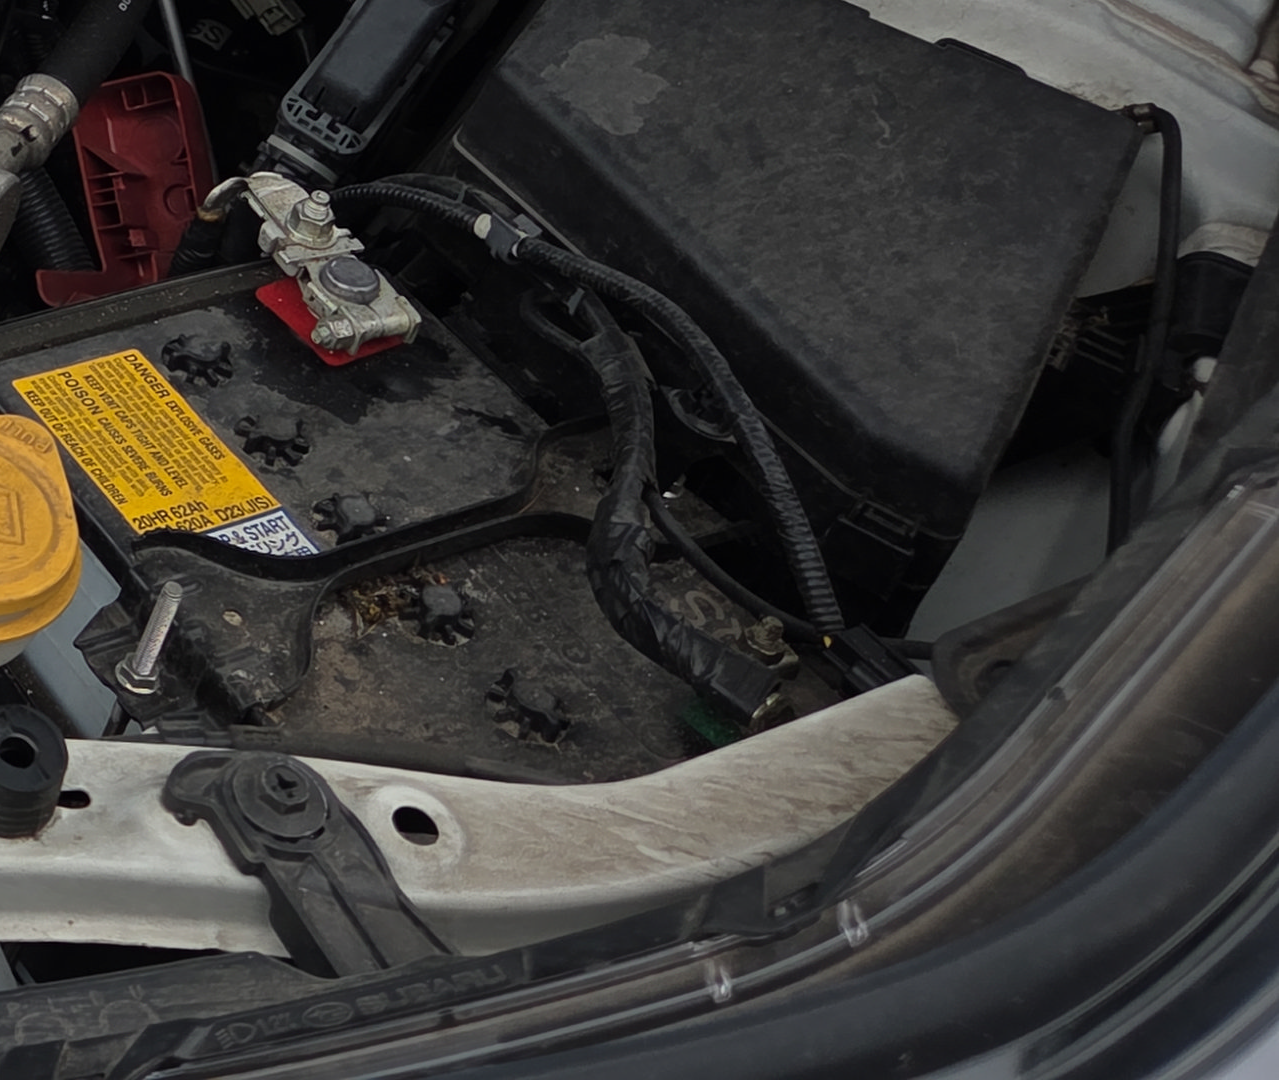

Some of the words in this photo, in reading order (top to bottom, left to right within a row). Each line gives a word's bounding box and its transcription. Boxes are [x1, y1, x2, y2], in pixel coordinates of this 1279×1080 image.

[23, 390, 46, 408] KEEP
[39, 408, 58, 422] OUT
[51, 423, 67, 433] OF
[60, 433, 88, 457] REACH
[80, 457, 97, 467] OF
[90, 468, 128, 504] CHILDREN
[57, 371, 104, 415] POISON
[96, 417, 128, 444] CAUSES
[121, 445, 151, 470] SEVERE
[144, 472, 173, 496] BURNS
[82, 374, 104, 391] KEEP
[98, 392, 120, 409] VENT
[113, 410, 137, 429] CAPS
[130, 429, 156, 450] TIGHT
[148, 450, 170, 466] AND
[162, 466, 190, 488] LEVEL
[122, 353, 171, 398] DANGER
[164, 400, 204, 436] EXPLOSIVE
[197, 437, 226, 460] GASES
[133, 512, 171, 530] 20HR
[172, 500, 208, 518] 62Ah
[215, 497, 273, 522] D23(JIS)
[247, 516, 291, 539] START
[354, 962, 508, 1019] SUBARU
